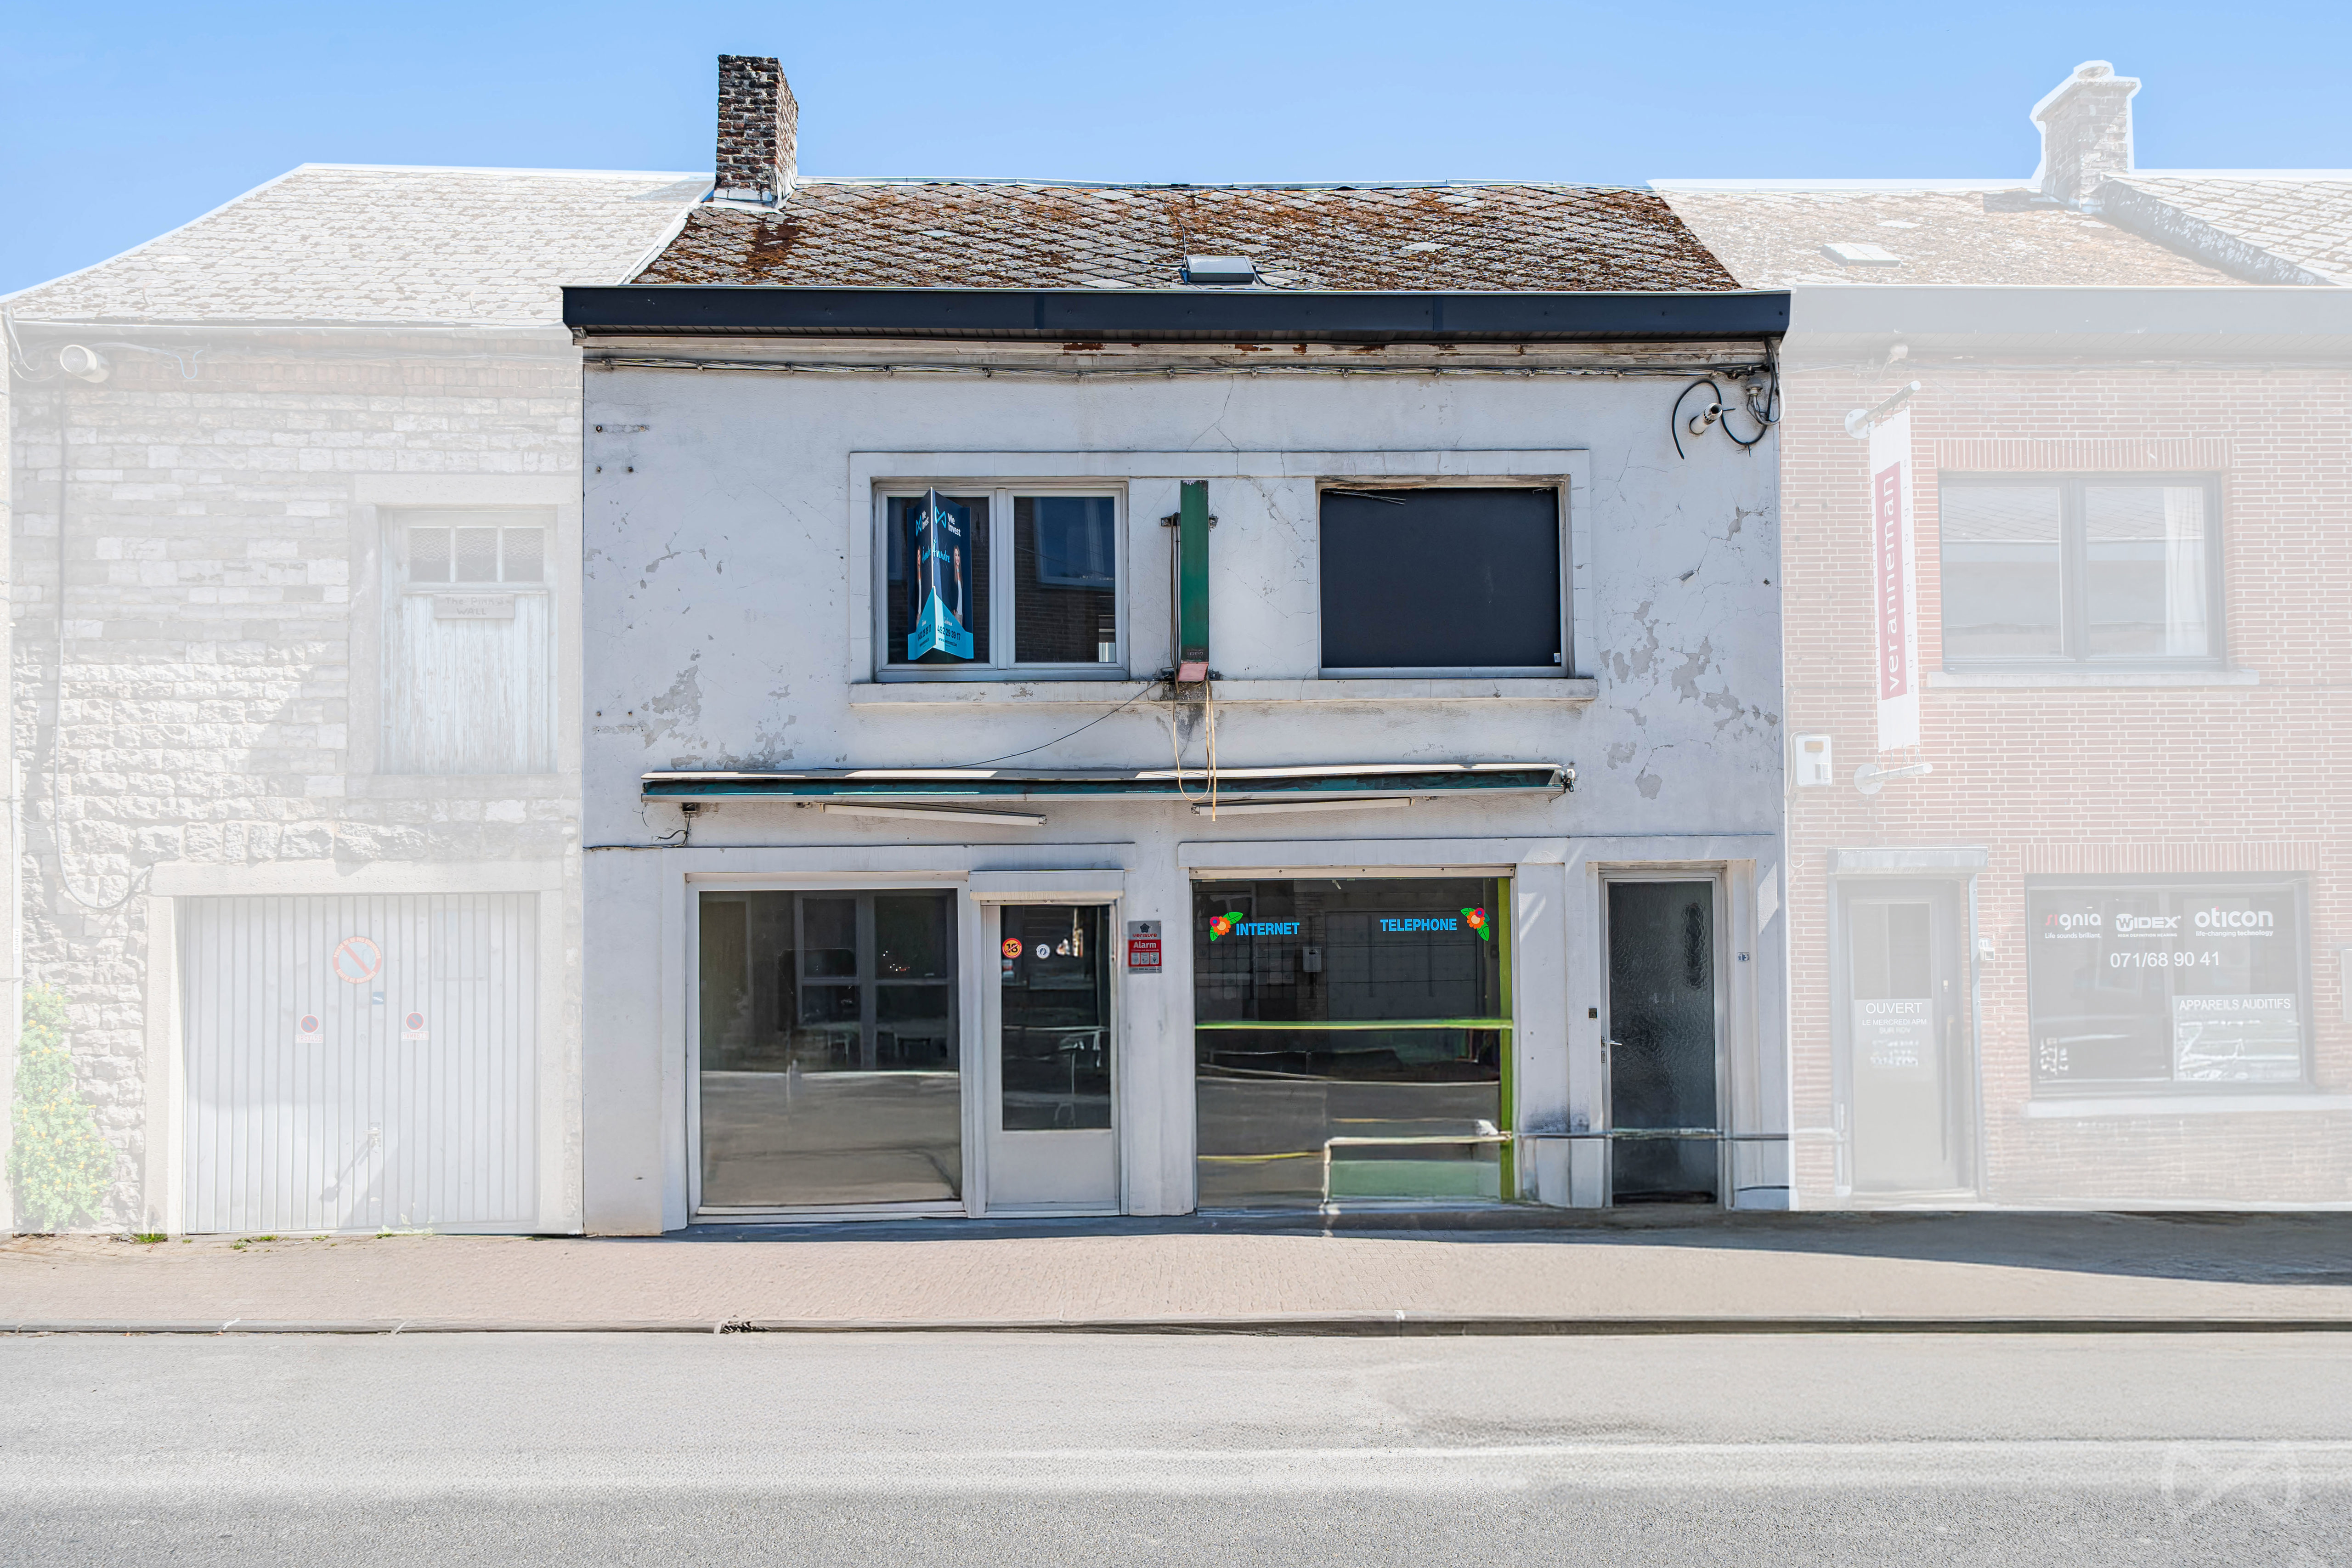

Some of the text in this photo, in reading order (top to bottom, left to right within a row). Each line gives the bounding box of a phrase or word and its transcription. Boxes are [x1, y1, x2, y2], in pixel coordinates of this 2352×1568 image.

[948, 513, 955, 525] We
[948, 522, 961, 537] Invest
[936, 549, 950, 563] vendre
[1884, 475, 1900, 692] veranneman
[456, 607, 487, 616] WALL
[946, 628, 950, 637] 29
[951, 630, 956, 639] 39
[2045, 913, 2102, 931] signia
[2115, 913, 2179, 932] WIDEX
[2194, 906, 2274, 928] oticon
[1236, 922, 1300, 936] INTERNET
[1380, 918, 1457, 932] TELEPHONE
[1006, 943, 1018, 953] 18
[2109, 951, 2220, 968] 071/68 90 41
[1865, 1002, 1922, 1014] OUVERT
[2178, 998, 2291, 1011] APPAREILS AUDITIFS
